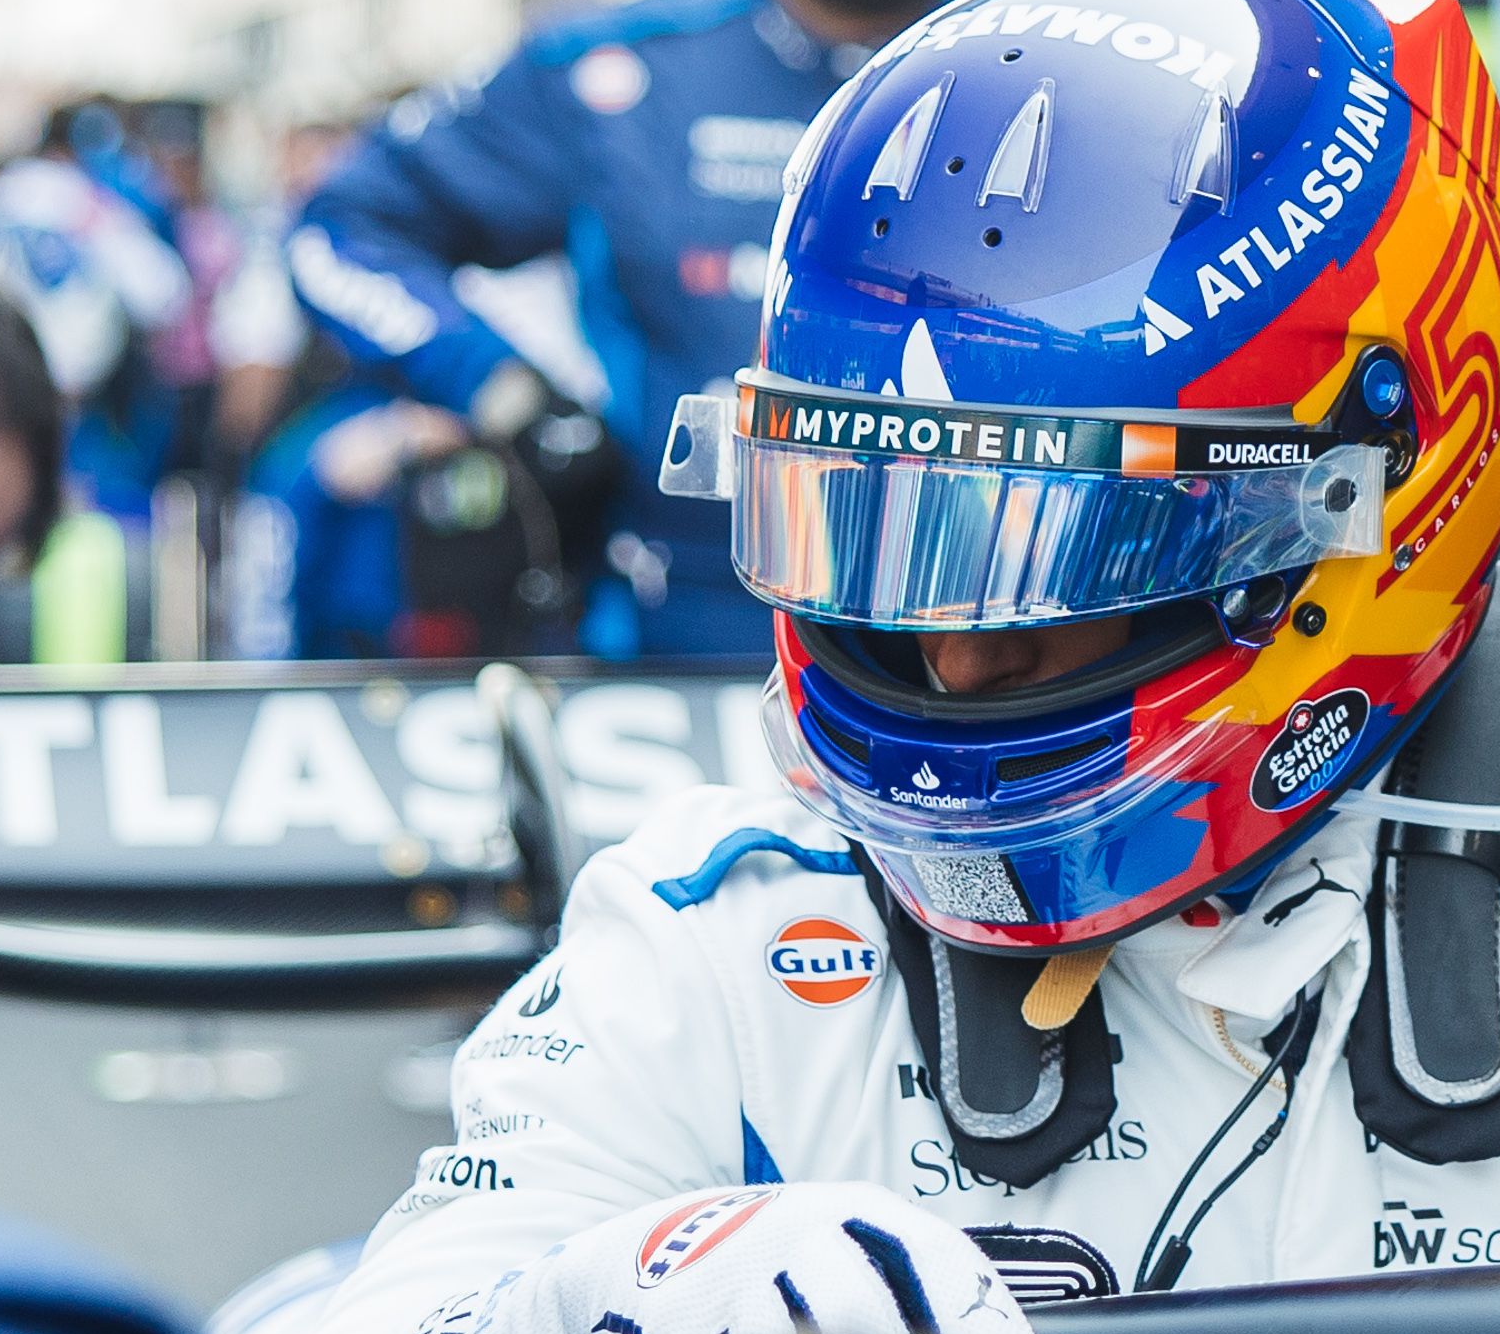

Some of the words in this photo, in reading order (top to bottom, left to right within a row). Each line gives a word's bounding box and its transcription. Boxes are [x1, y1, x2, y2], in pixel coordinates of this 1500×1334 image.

[1195, 67, 1391, 320] ATLASSIAN
[793, 407, 1067, 465] MYPROTEIN
[1208, 442, 1315, 465] DURACELL
[1415, 428, 1500, 554] CARLOS
[1268, 704, 1349, 781] Estrella
[1278, 726, 1351, 793] Galicia
[891, 786, 968, 810] Santander
[771, 947, 877, 974] Gulf
